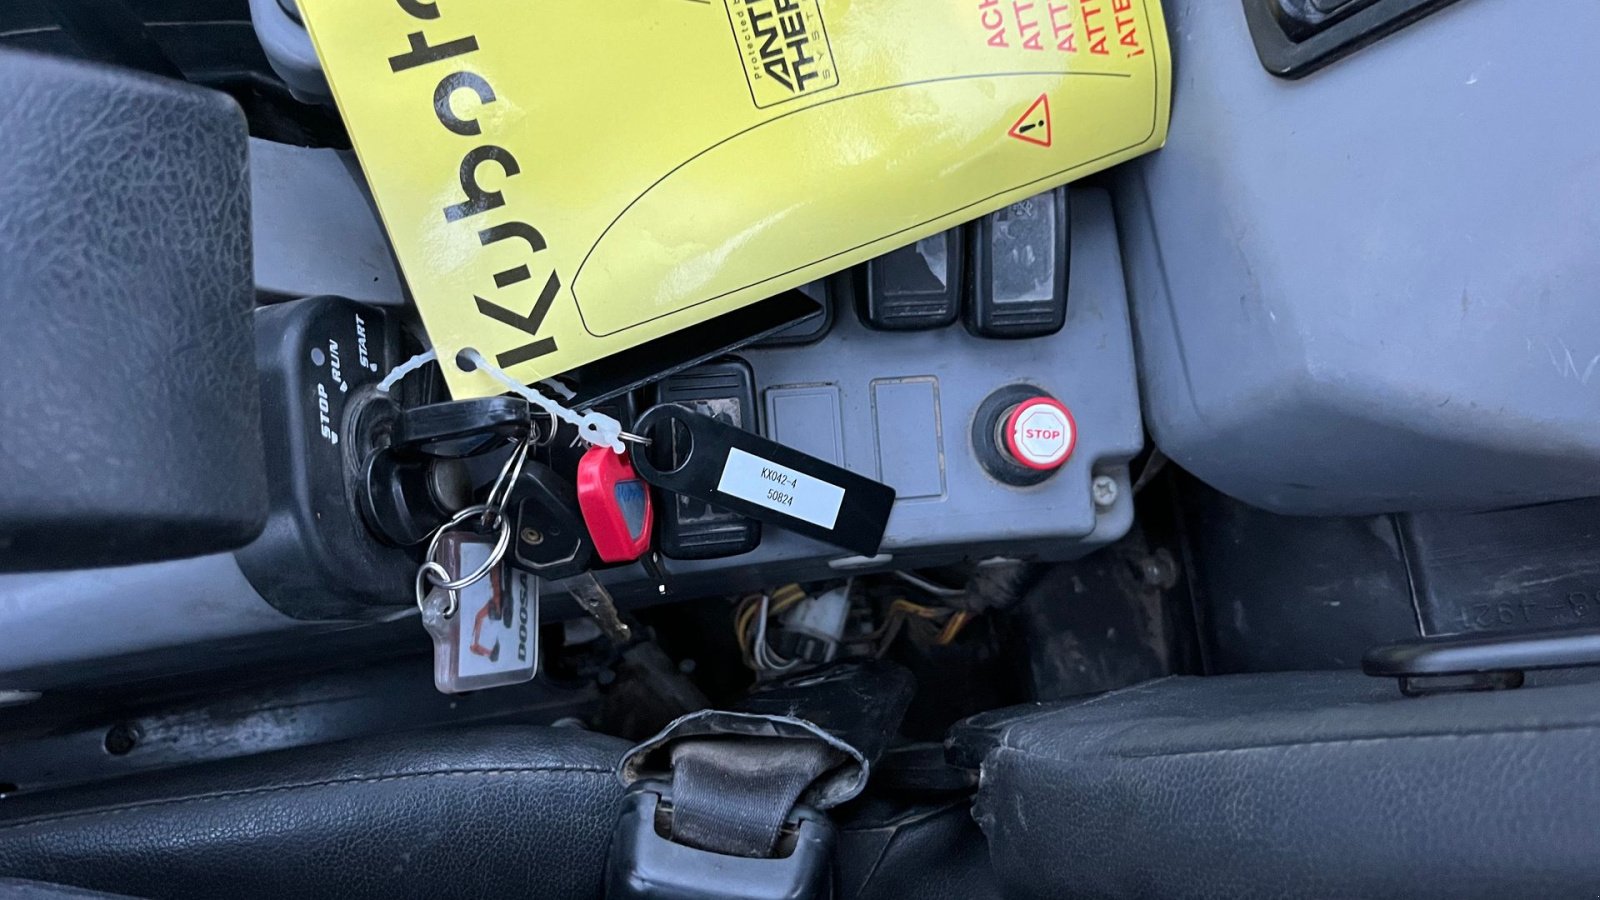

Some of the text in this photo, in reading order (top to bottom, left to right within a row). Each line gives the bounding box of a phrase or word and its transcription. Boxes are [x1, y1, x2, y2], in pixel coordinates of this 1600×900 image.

[736, 11, 762, 80] Protected
[1080, 0, 1109, 55] ATT
[388, 0, 561, 369] Kubot
[329, 339, 342, 383] RUN
[355, 303, 370, 369] START
[317, 382, 332, 439] STOP
[1026, 429, 1061, 440] STOP
[760, 467, 798, 489] KX042-4
[766, 488, 794, 507] 50824
[517, 573, 529, 662] DOOSA
